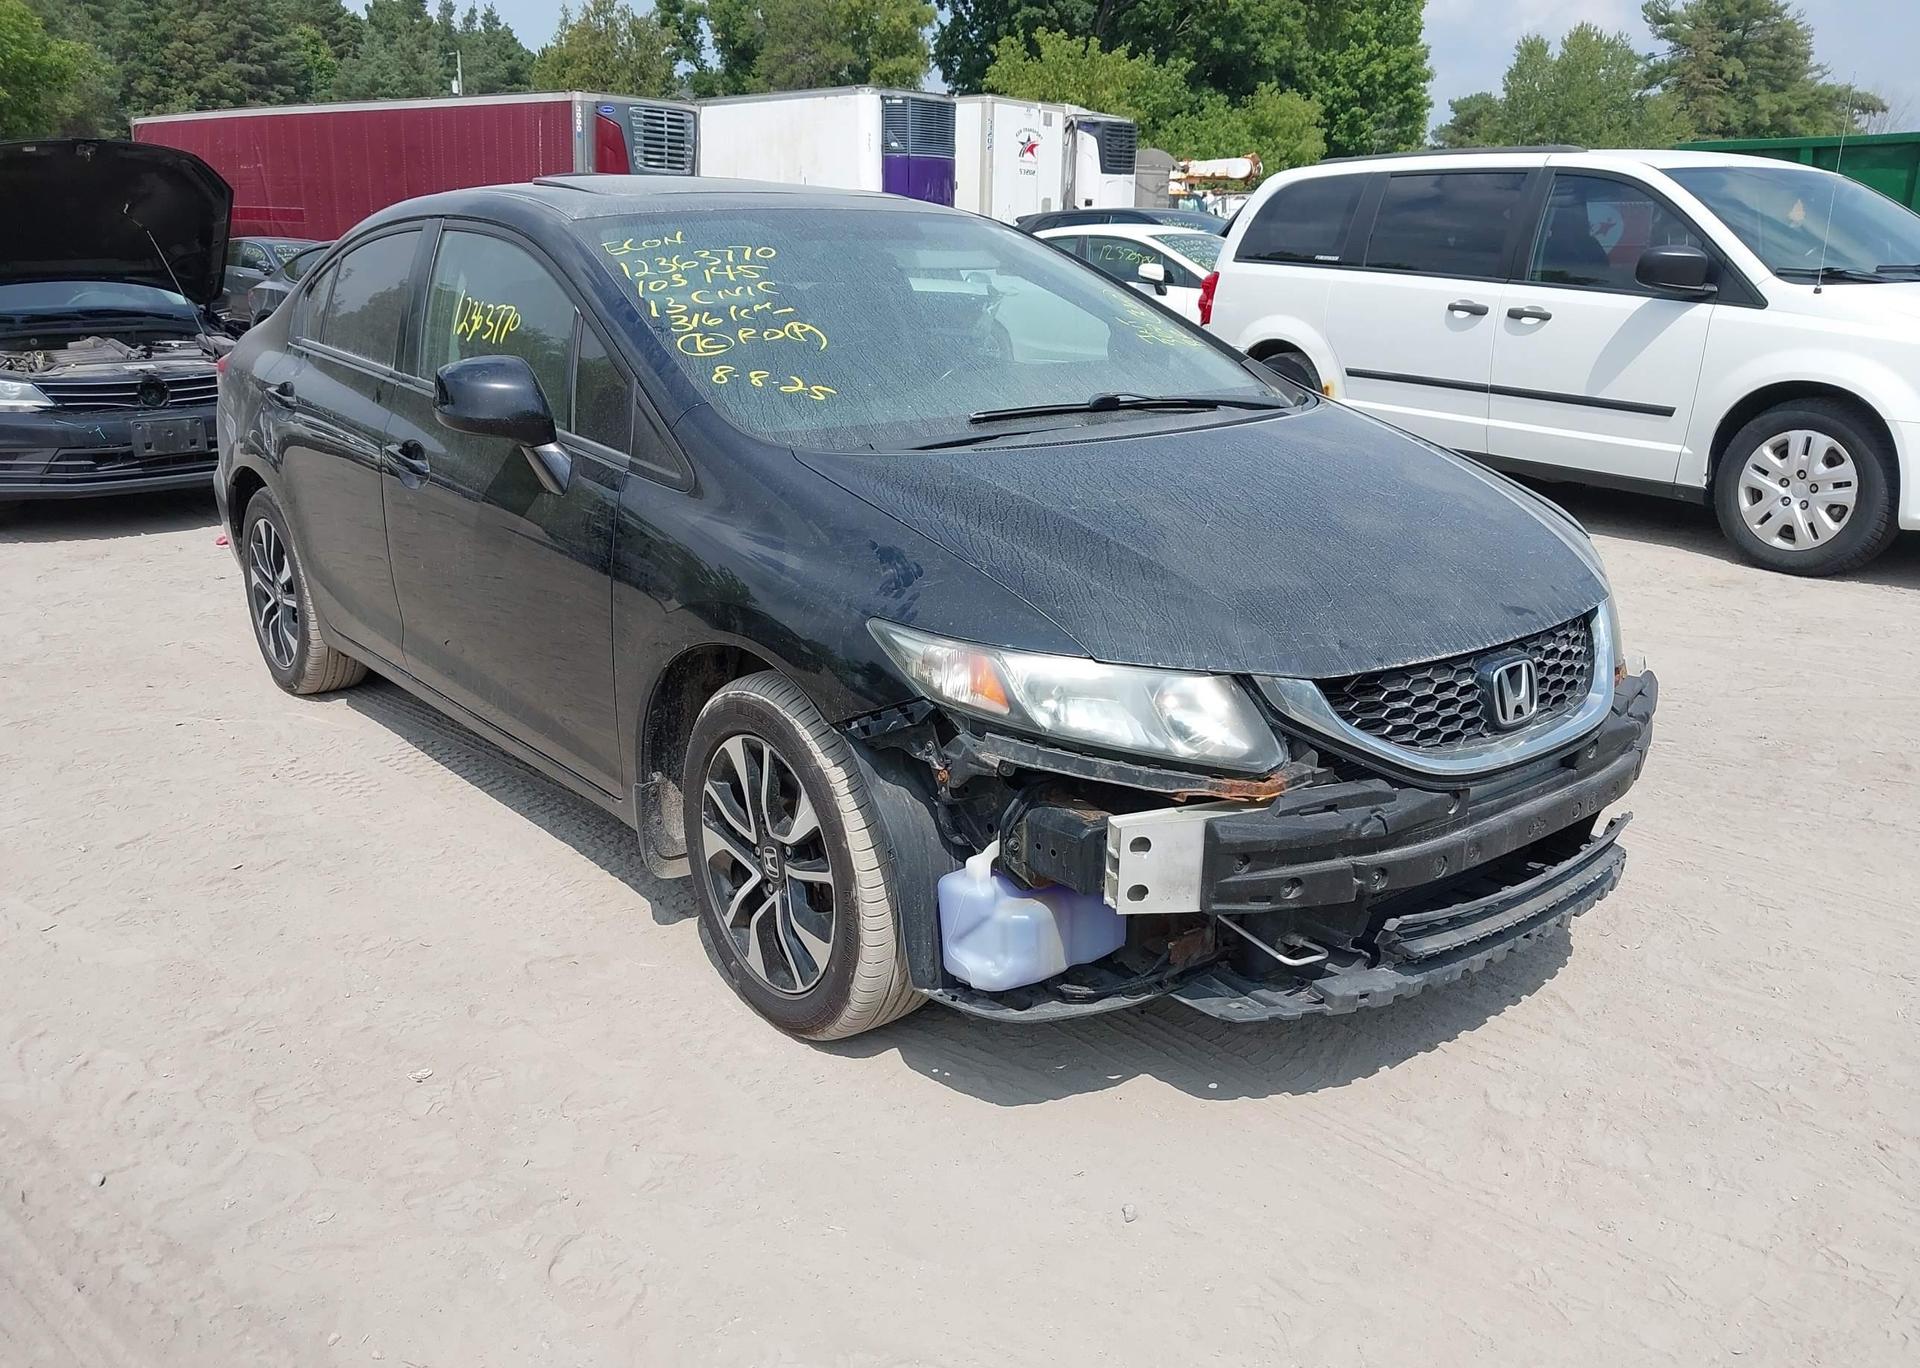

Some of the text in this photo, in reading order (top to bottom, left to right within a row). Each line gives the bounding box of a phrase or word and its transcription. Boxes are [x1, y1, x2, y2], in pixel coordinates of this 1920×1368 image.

[601, 231, 686, 255] ECON
[620, 246, 776, 280] 12363770
[670, 311, 723, 332] 316
